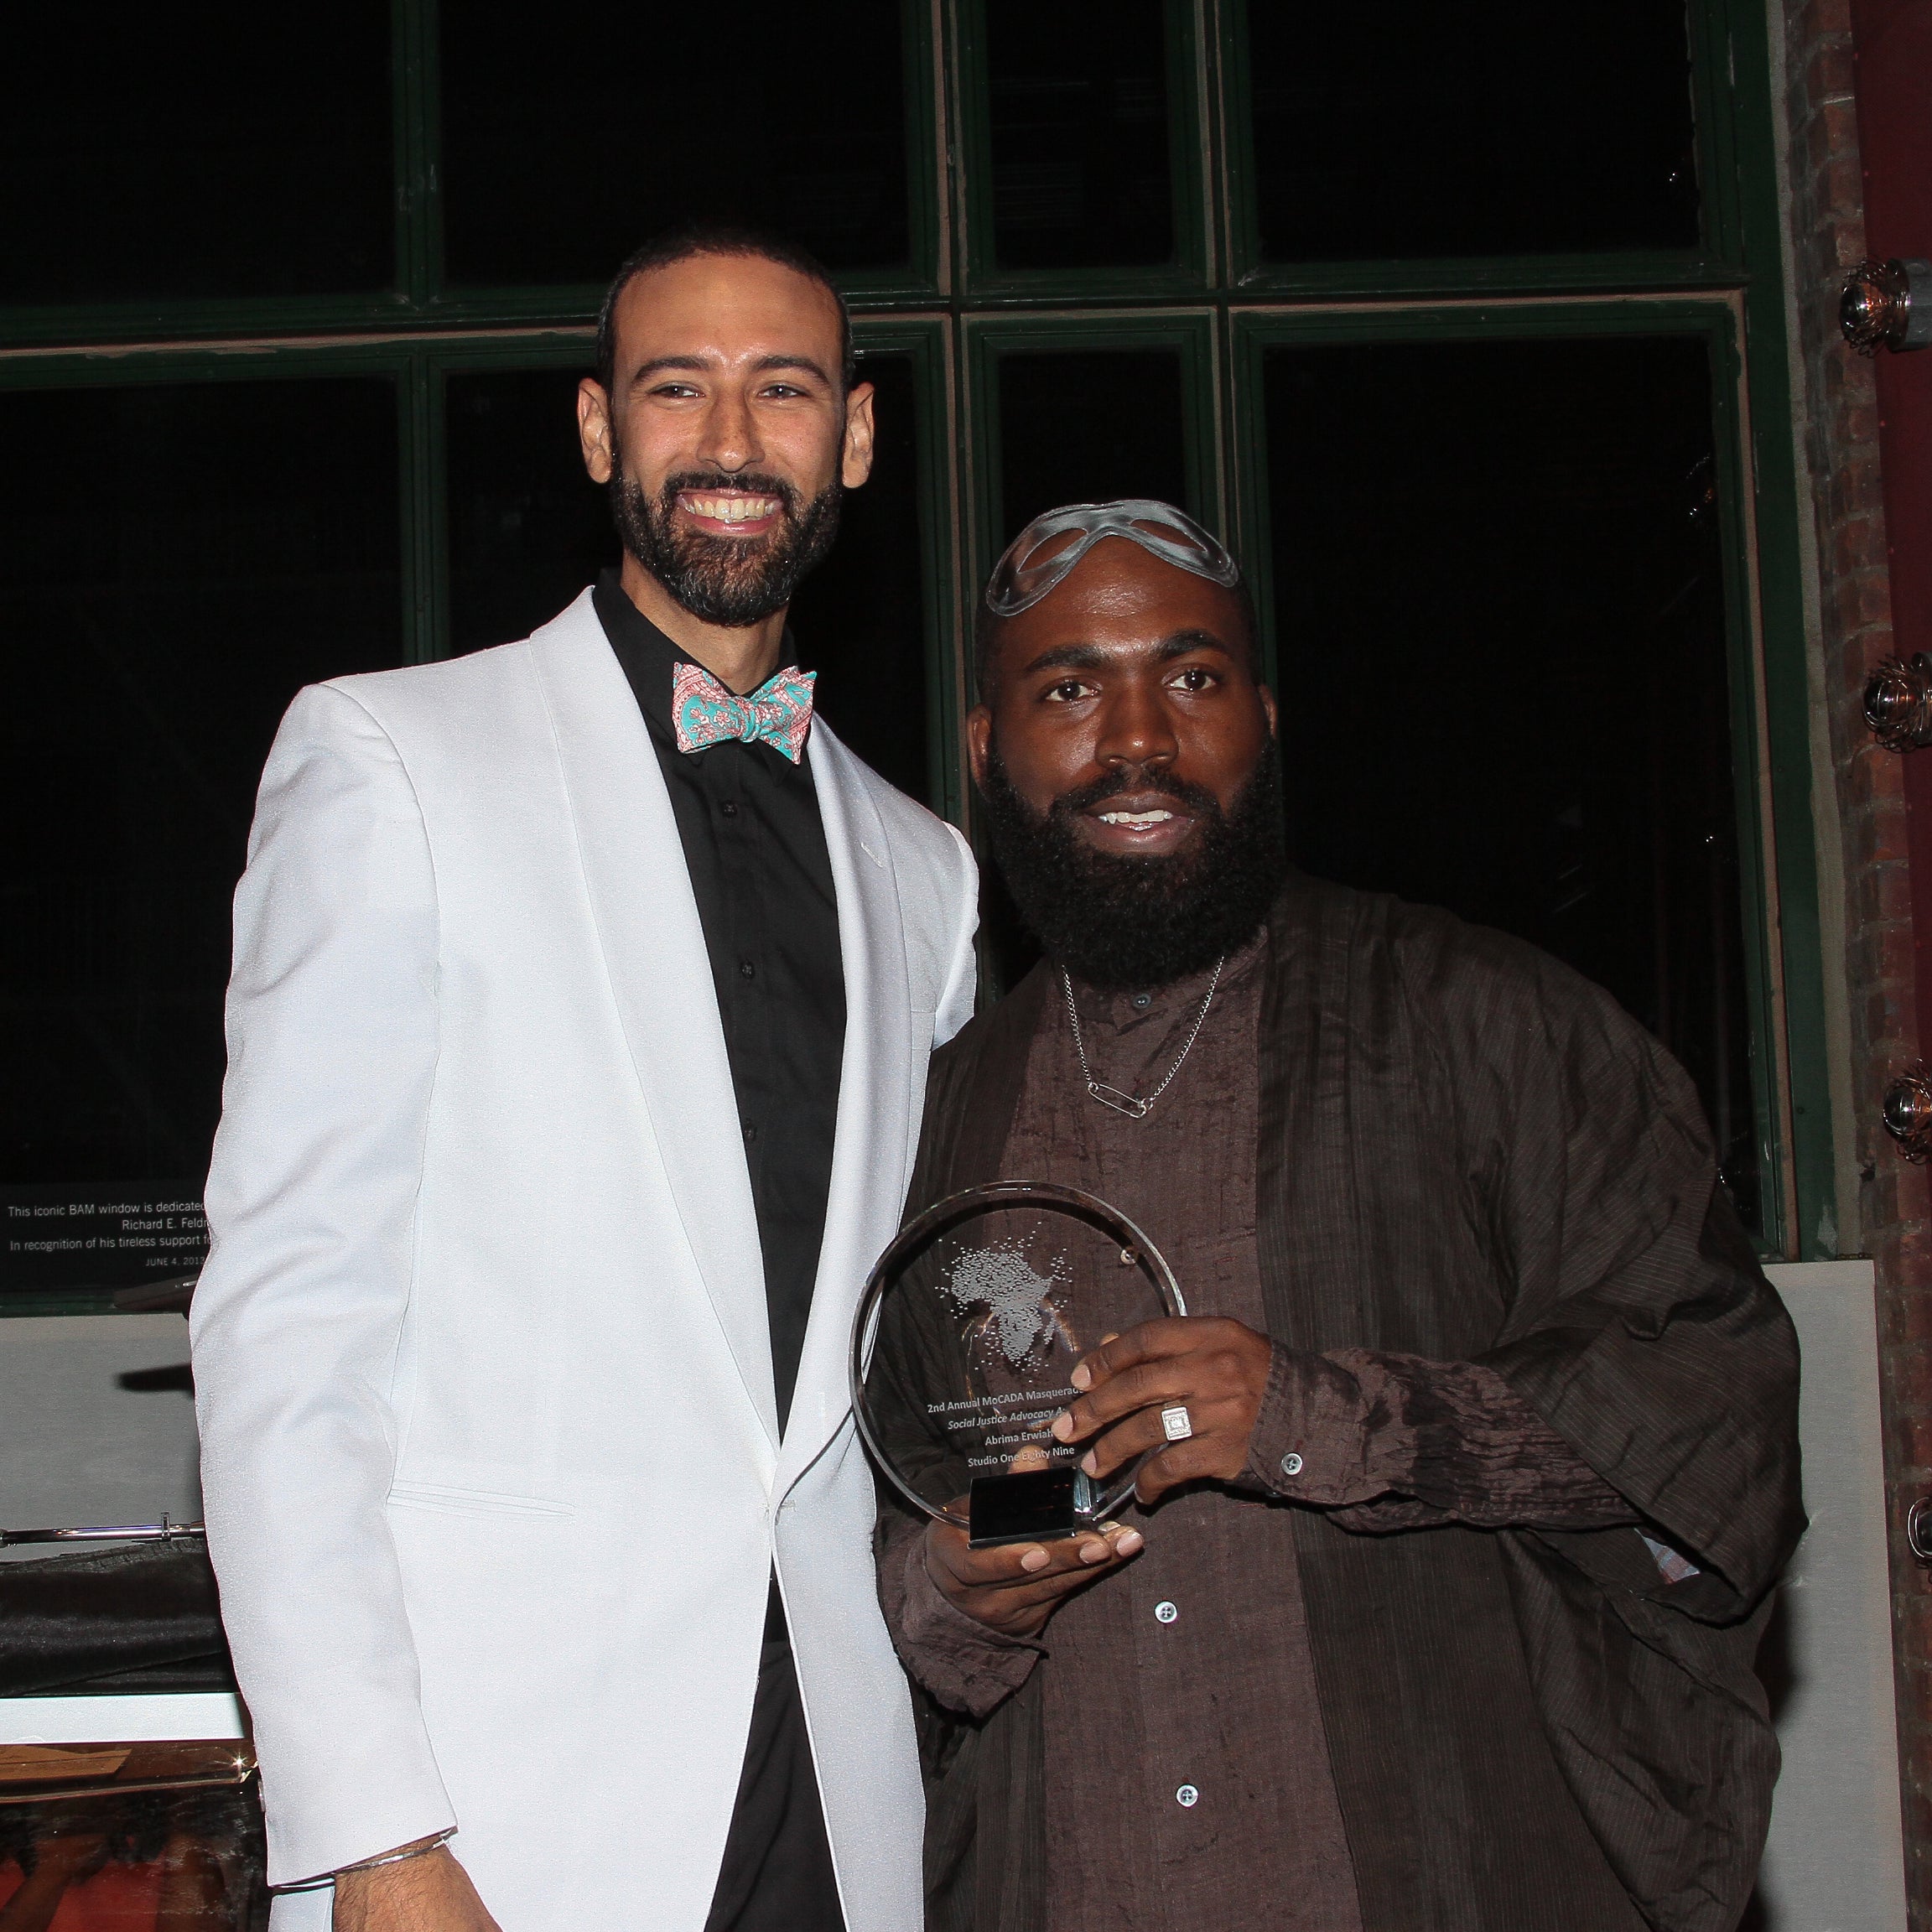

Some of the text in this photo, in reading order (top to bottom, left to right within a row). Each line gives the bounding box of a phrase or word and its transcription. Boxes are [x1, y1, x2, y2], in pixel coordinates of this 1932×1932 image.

[8, 1207, 31, 1217] This
[34, 1205, 65, 1216] iconic
[69, 1204, 95, 1215] BAM
[98, 1203, 140, 1214] window
[144, 1202, 153, 1213] is
[122, 1219, 163, 1231] Richard
[167, 1218, 177, 1229] E.
[10, 1241, 20, 1251] In
[24, 1239, 82, 1252] recognition
[86, 1237, 96, 1249] of
[100, 1236, 116, 1248] his
[119, 1235, 156, 1247] tireless
[159, 1235, 200, 1247] support
[145, 1258, 169, 1266] JUNE
[927, 1402, 945, 1414] 2nd
[948, 1397, 980, 1410] Annual
[982, 1393, 1024, 1407] MoCADA
[948, 1418, 975, 1431] Social
[977, 1415, 1007, 1426] Justice
[1010, 1410, 1054, 1421] Advocacy
[985, 1429, 1053, 1446] Abrima Erwiah
[968, 1446, 1075, 1467] Studio One Eighty Nine
